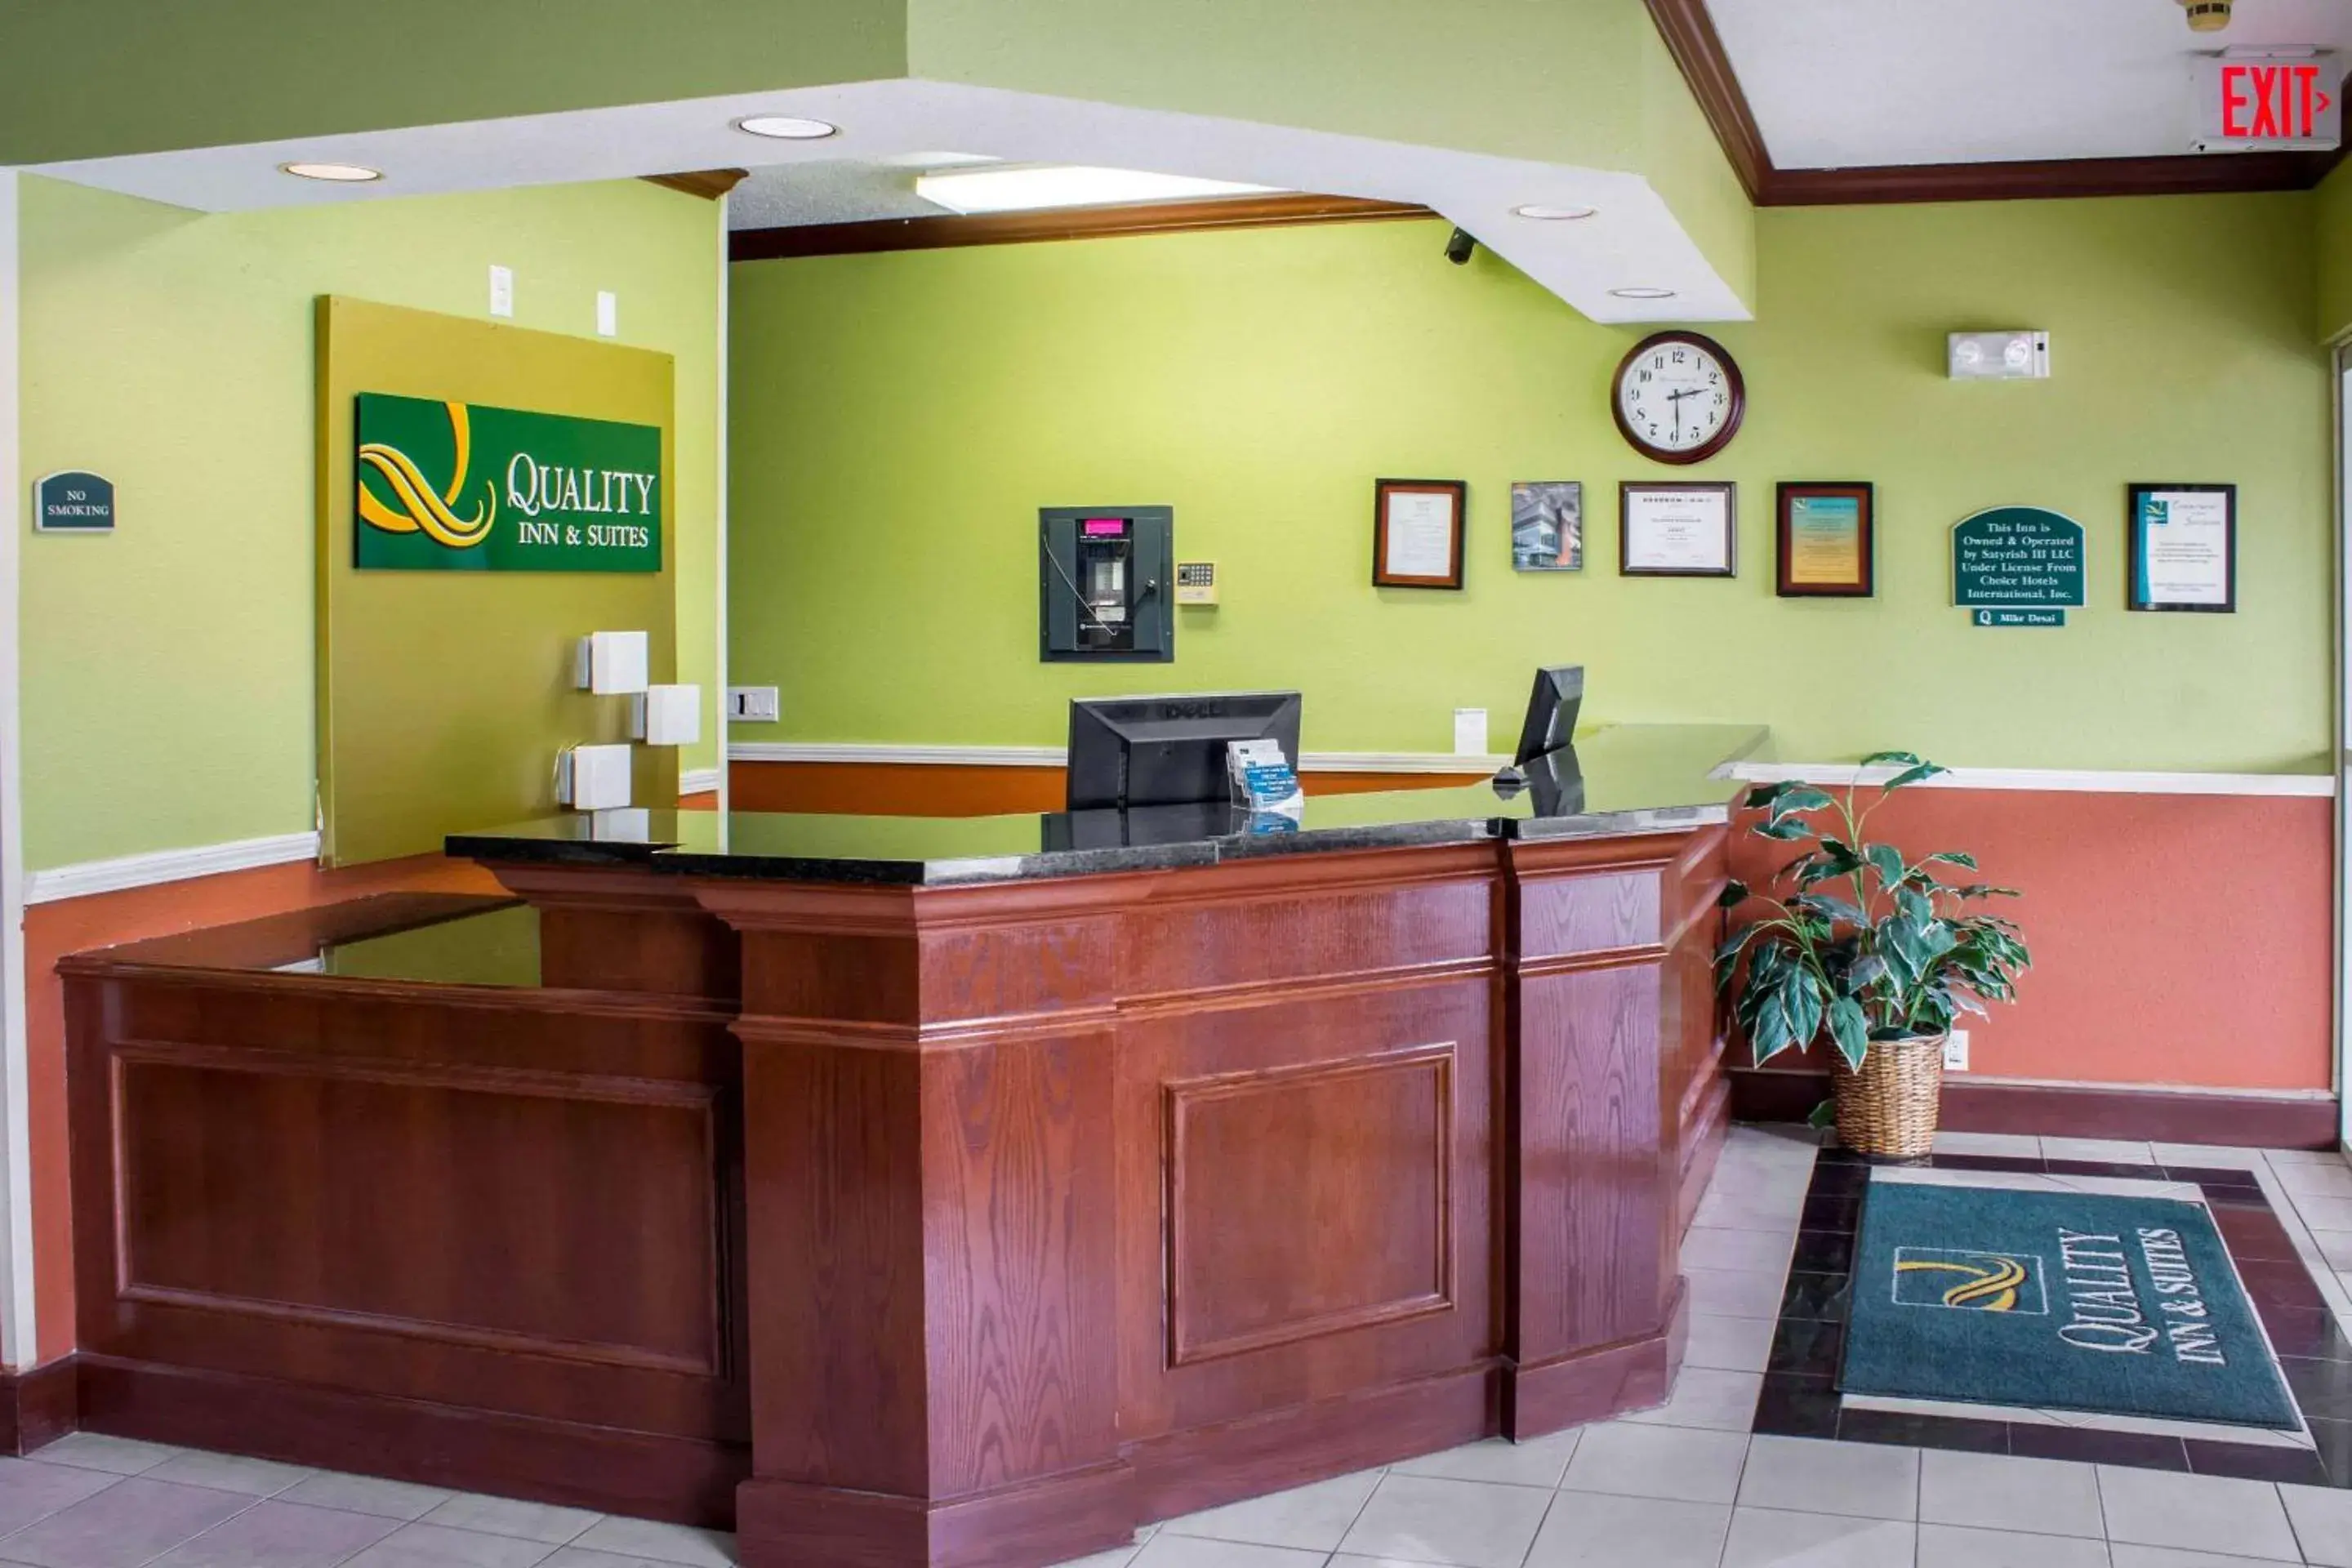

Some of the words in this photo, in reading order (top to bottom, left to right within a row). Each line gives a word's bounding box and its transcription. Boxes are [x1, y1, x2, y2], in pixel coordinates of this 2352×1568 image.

[2221, 66, 2319, 138] EXIT
[1655, 356, 1664, 369] 11
[1672, 350, 1684, 363] 12
[1696, 357, 1701, 371] 1
[1640, 369, 1652, 382] 10
[1708, 371, 1717, 385] 2
[1632, 389, 1641, 401] 9
[1713, 393, 1722, 405] 3
[507, 452, 656, 517] QUALITY
[66, 490, 87, 501] NO
[47, 505, 109, 516] SMOKING
[1987, 523, 2011, 532] This
[2016, 523, 2036, 532] Inn
[2041, 523, 2051, 532] is
[518, 522, 559, 546] INN
[566, 525, 581, 546] &
[588, 524, 649, 548] SUITES
[1963, 536, 2003, 546] Owned
[2007, 536, 2017, 546] &
[2022, 536, 2074, 548] Operated
[1964, 550, 1977, 561] by
[1981, 550, 2028, 561] Satyrish
[2051, 550, 2074, 559] LLC
[1962, 563, 1998, 572] Under
[2002, 563, 2043, 572] License
[2047, 564, 2077, 572] From
[1980, 576, 2018, 586] Choice
[2022, 576, 2059, 586] Hotels
[1967, 590, 2046, 599] International,
[2050, 590, 2073, 599] Inc.
[2000, 614, 2025, 622] Mike
[2029, 614, 2056, 622] Desai
[2137, 1227, 2198, 1296] SUITES
[2057, 1227, 2158, 1355] QUALITY
[2160, 1299, 2207, 1316] &
[2166, 1321, 2225, 1365] INN
